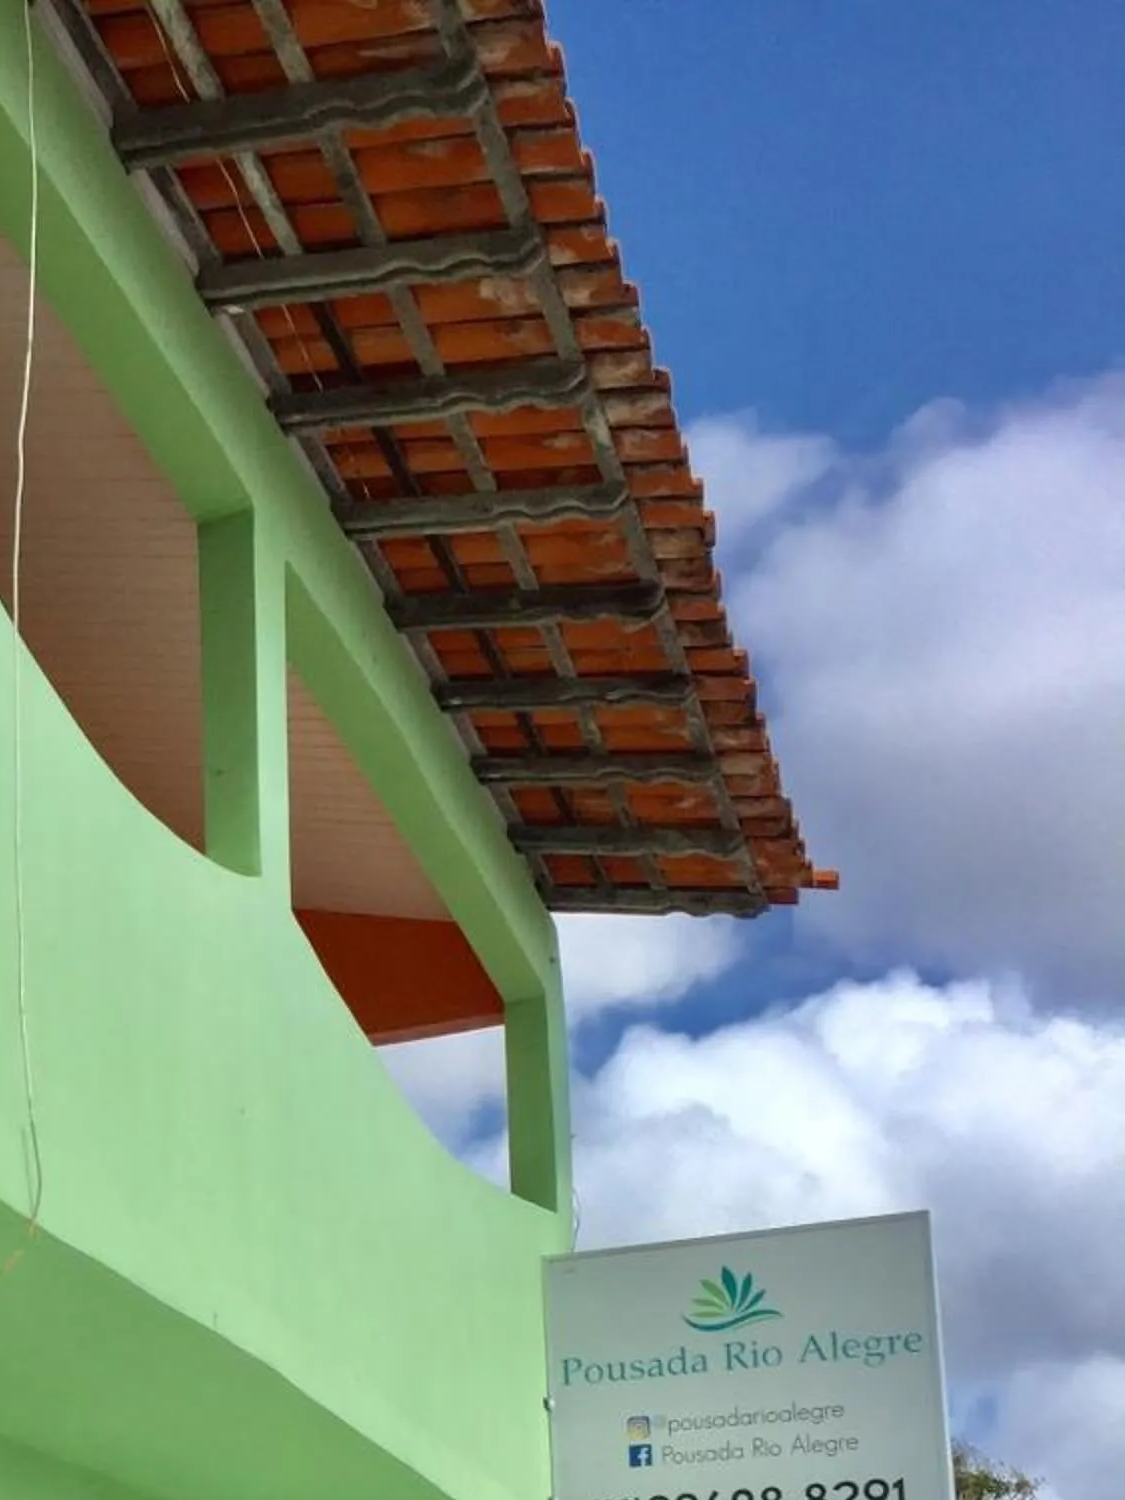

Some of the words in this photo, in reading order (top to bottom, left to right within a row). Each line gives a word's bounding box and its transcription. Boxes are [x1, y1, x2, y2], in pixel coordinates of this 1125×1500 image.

[562, 1346, 709, 1387] Pousada
[724, 1340, 784, 1372] Rio
[799, 1329, 924, 1367] Alegre
[668, 1401, 845, 1436] pousadarioalegre
[662, 1441, 744, 1465] Pousada
[752, 1437, 782, 1458] Rio
[790, 1433, 859, 1457] Alegre
